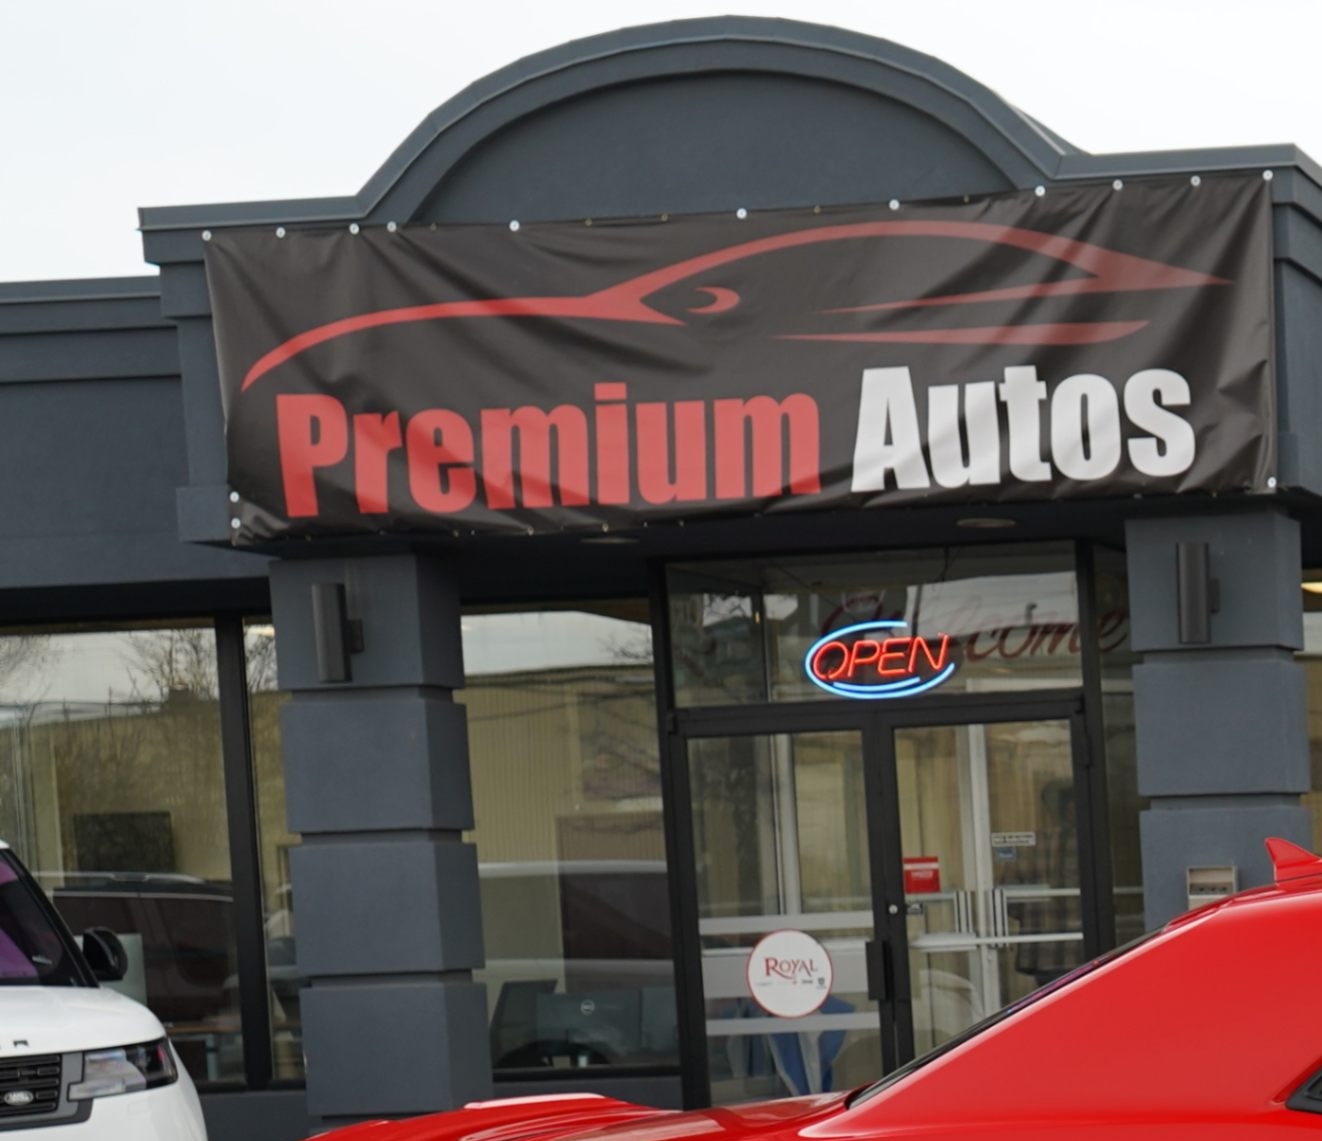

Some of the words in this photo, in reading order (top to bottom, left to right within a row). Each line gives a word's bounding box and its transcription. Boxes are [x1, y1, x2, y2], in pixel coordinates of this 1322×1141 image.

[276, 382, 821, 517] Premium
[851, 365, 1195, 492] Autos
[812, 633, 949, 680] OPEN
[764, 957, 818, 979] ROYAL
